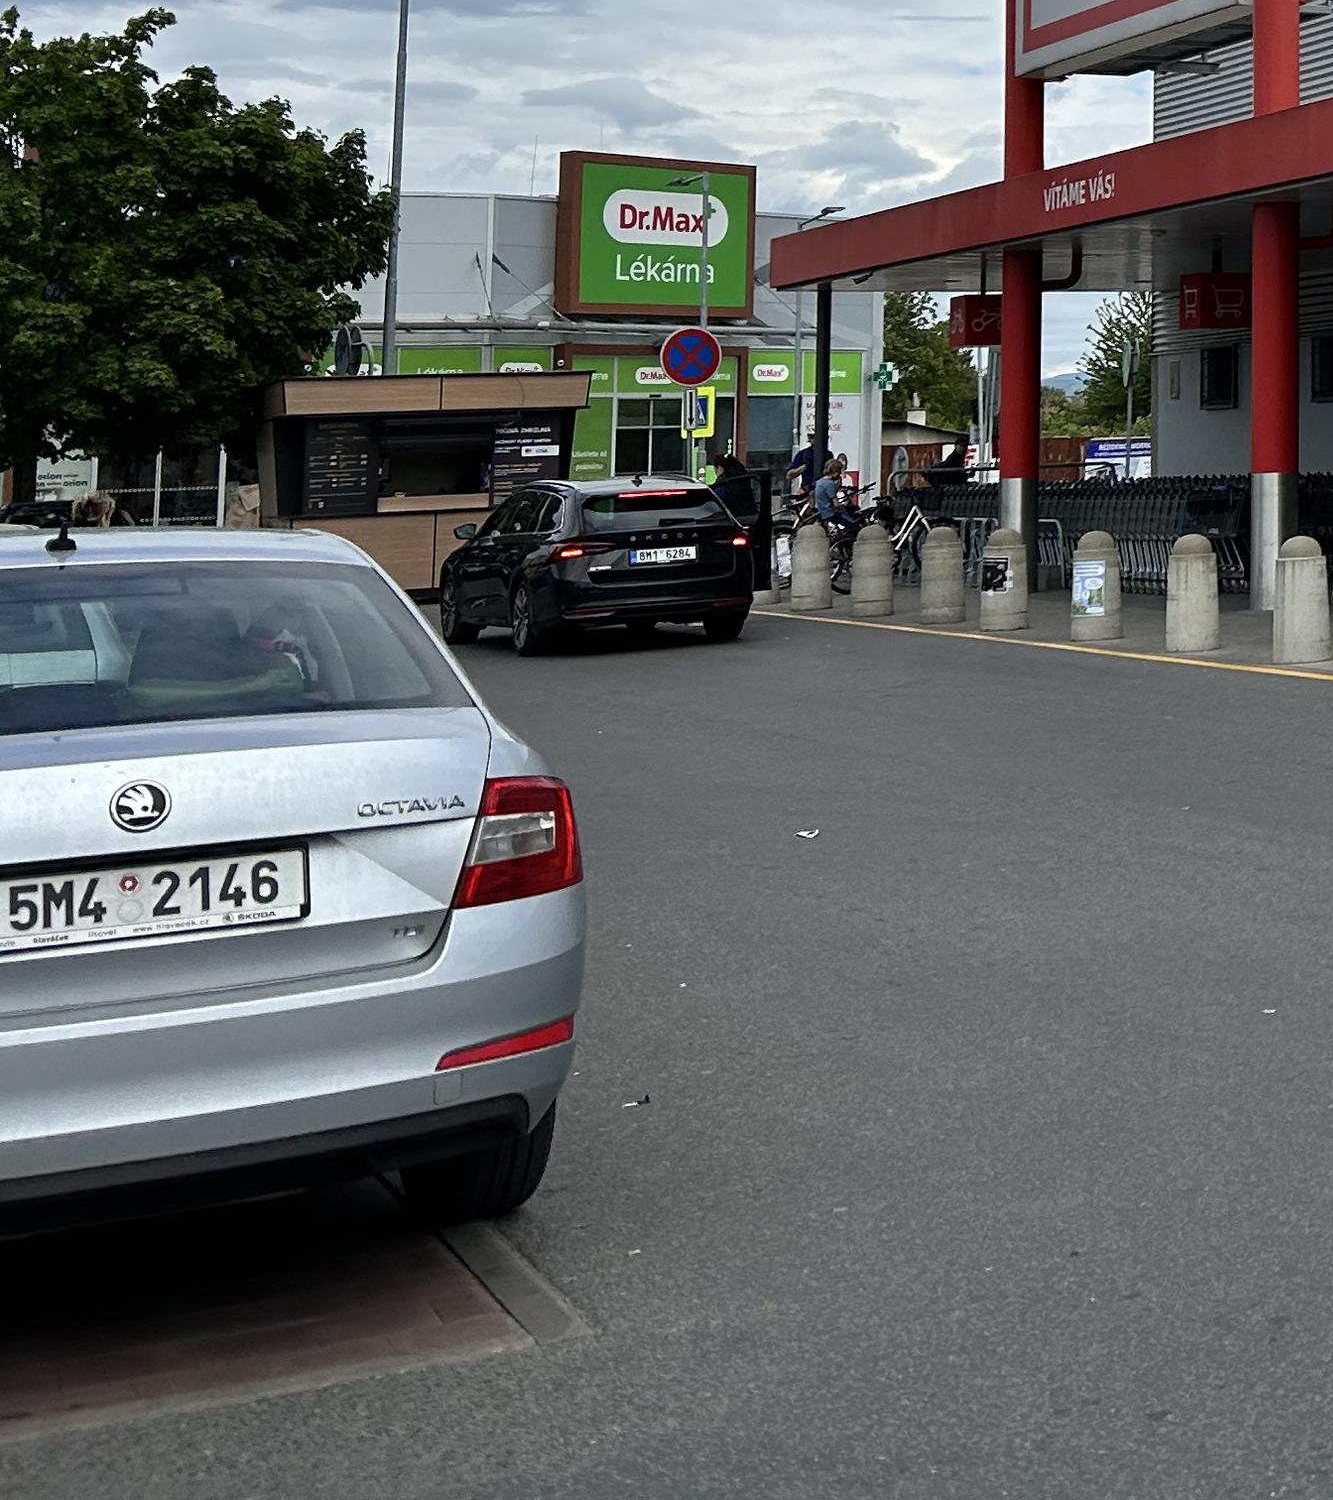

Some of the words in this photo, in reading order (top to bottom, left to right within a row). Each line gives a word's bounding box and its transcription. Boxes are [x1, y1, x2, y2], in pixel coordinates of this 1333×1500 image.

[1043, 178, 1086, 212] VÍTÁME
[1088, 169, 1115, 202] VÁS!
[619, 203, 705, 233] Dr.Max
[615, 254, 715, 284] Lékárna
[666, 548, 691, 559] 6284
[357, 794, 466, 817] OCTAVIA
[8, 877, 107, 931] 5M4
[151, 859, 280, 918] 2146
